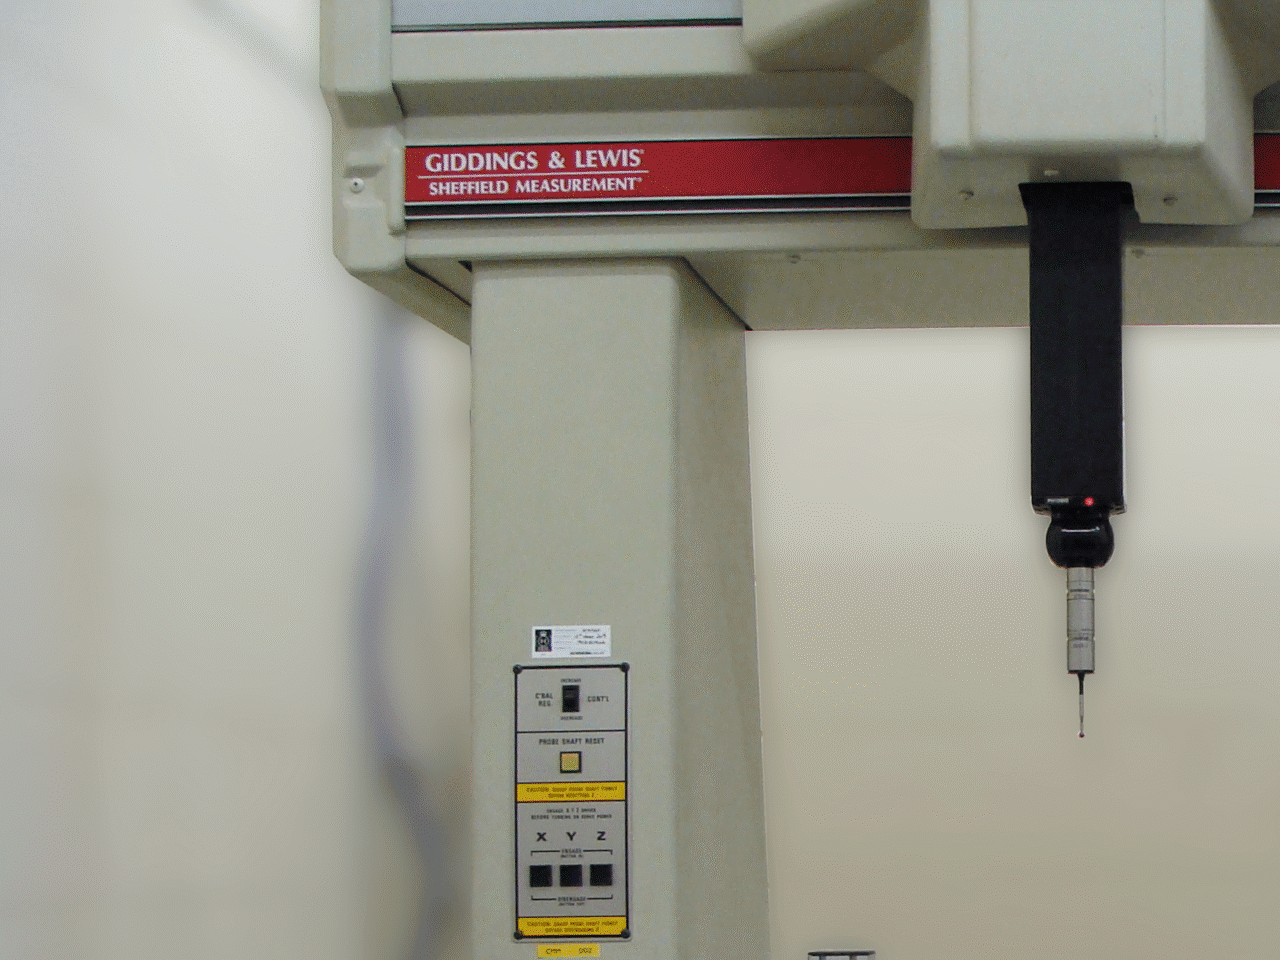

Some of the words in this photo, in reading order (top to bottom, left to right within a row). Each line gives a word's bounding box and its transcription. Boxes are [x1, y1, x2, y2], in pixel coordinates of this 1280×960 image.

[424, 150, 539, 173] GIDDINGS
[548, 151, 566, 170] &
[428, 179, 510, 197] SHEFFIELD
[536, 831, 547, 842] X
[566, 831, 577, 841] Y
[597, 830, 607, 841] Z
